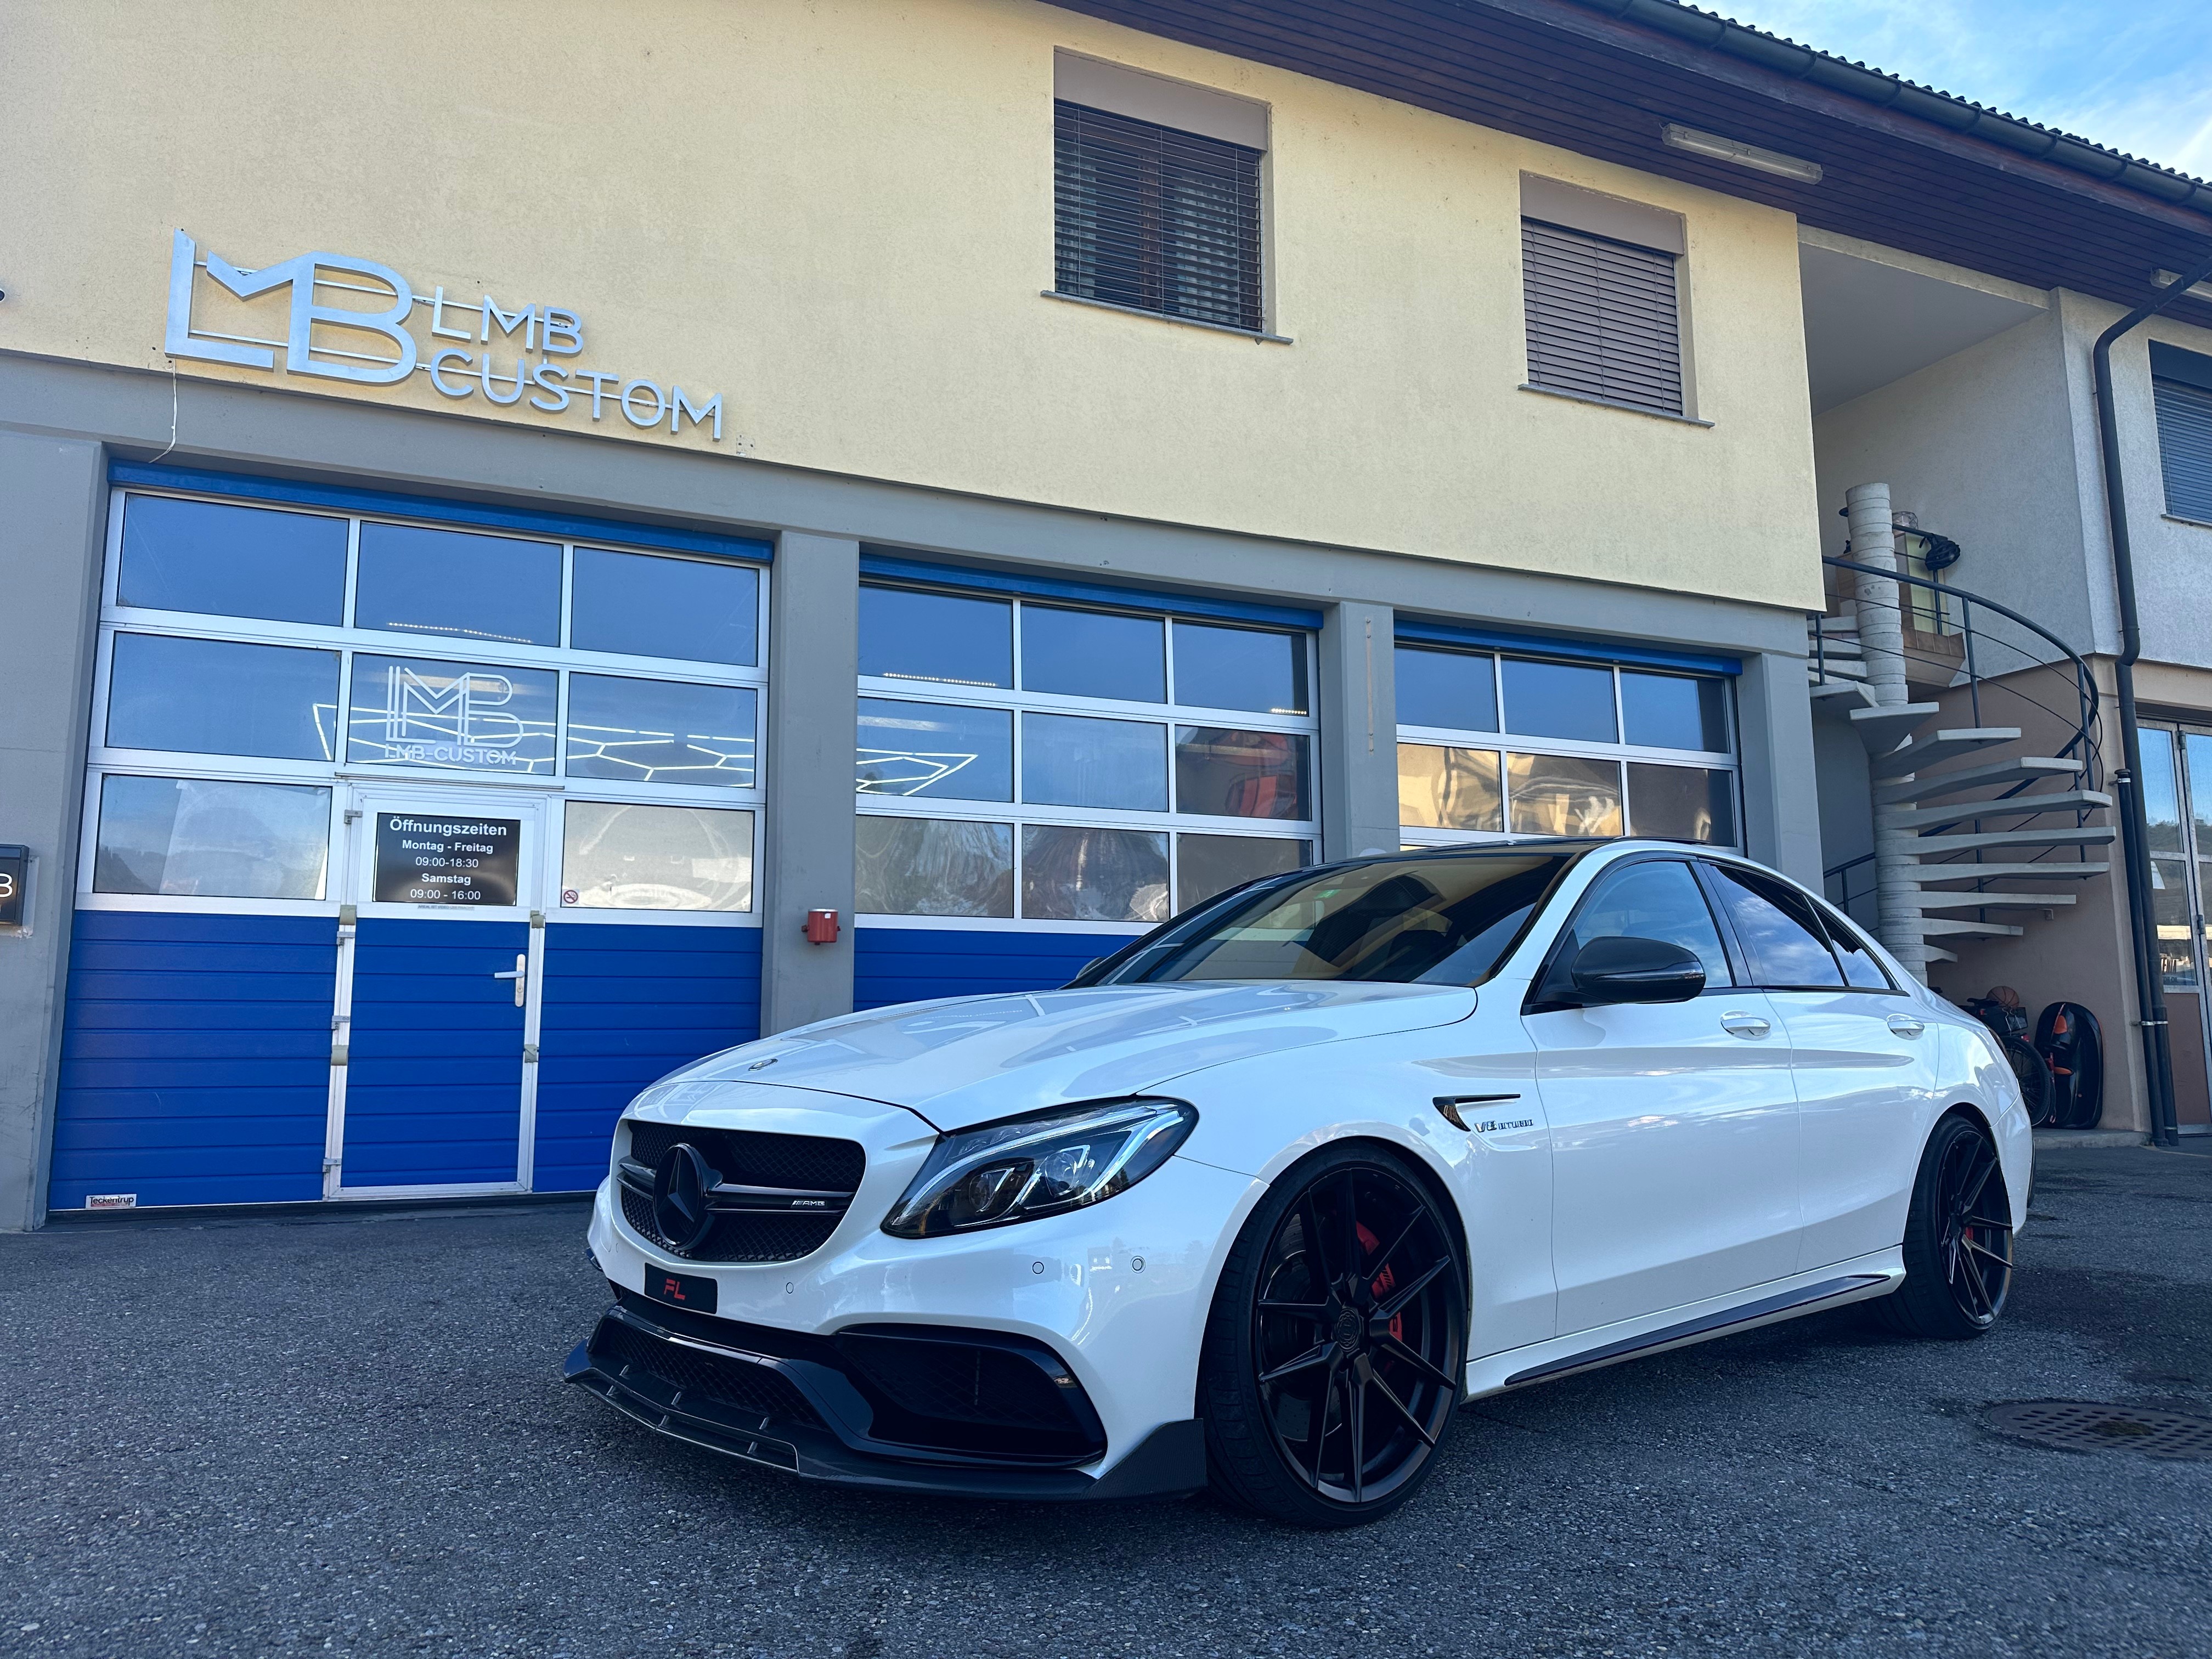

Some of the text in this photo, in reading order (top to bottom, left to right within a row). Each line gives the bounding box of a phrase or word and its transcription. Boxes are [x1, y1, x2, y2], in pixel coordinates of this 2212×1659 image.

[432, 286, 584, 358] LMB
[431, 348, 723, 441] CUSTOM
[385, 743, 516, 765] LMB-CUSTOM
[390, 816, 507, 836] Öffnungszeiten
[402, 840, 444, 853] Montag
[454, 842, 494, 854] Freitag
[415, 856, 479, 868] 09:00-18:30
[421, 873, 471, 885] Samstag
[410, 889, 441, 899] 09:00
[452, 890, 481, 900] 16:00
[1474, 1121, 1497, 1133] V8
[89, 1196, 134, 1206] Teckentrup
